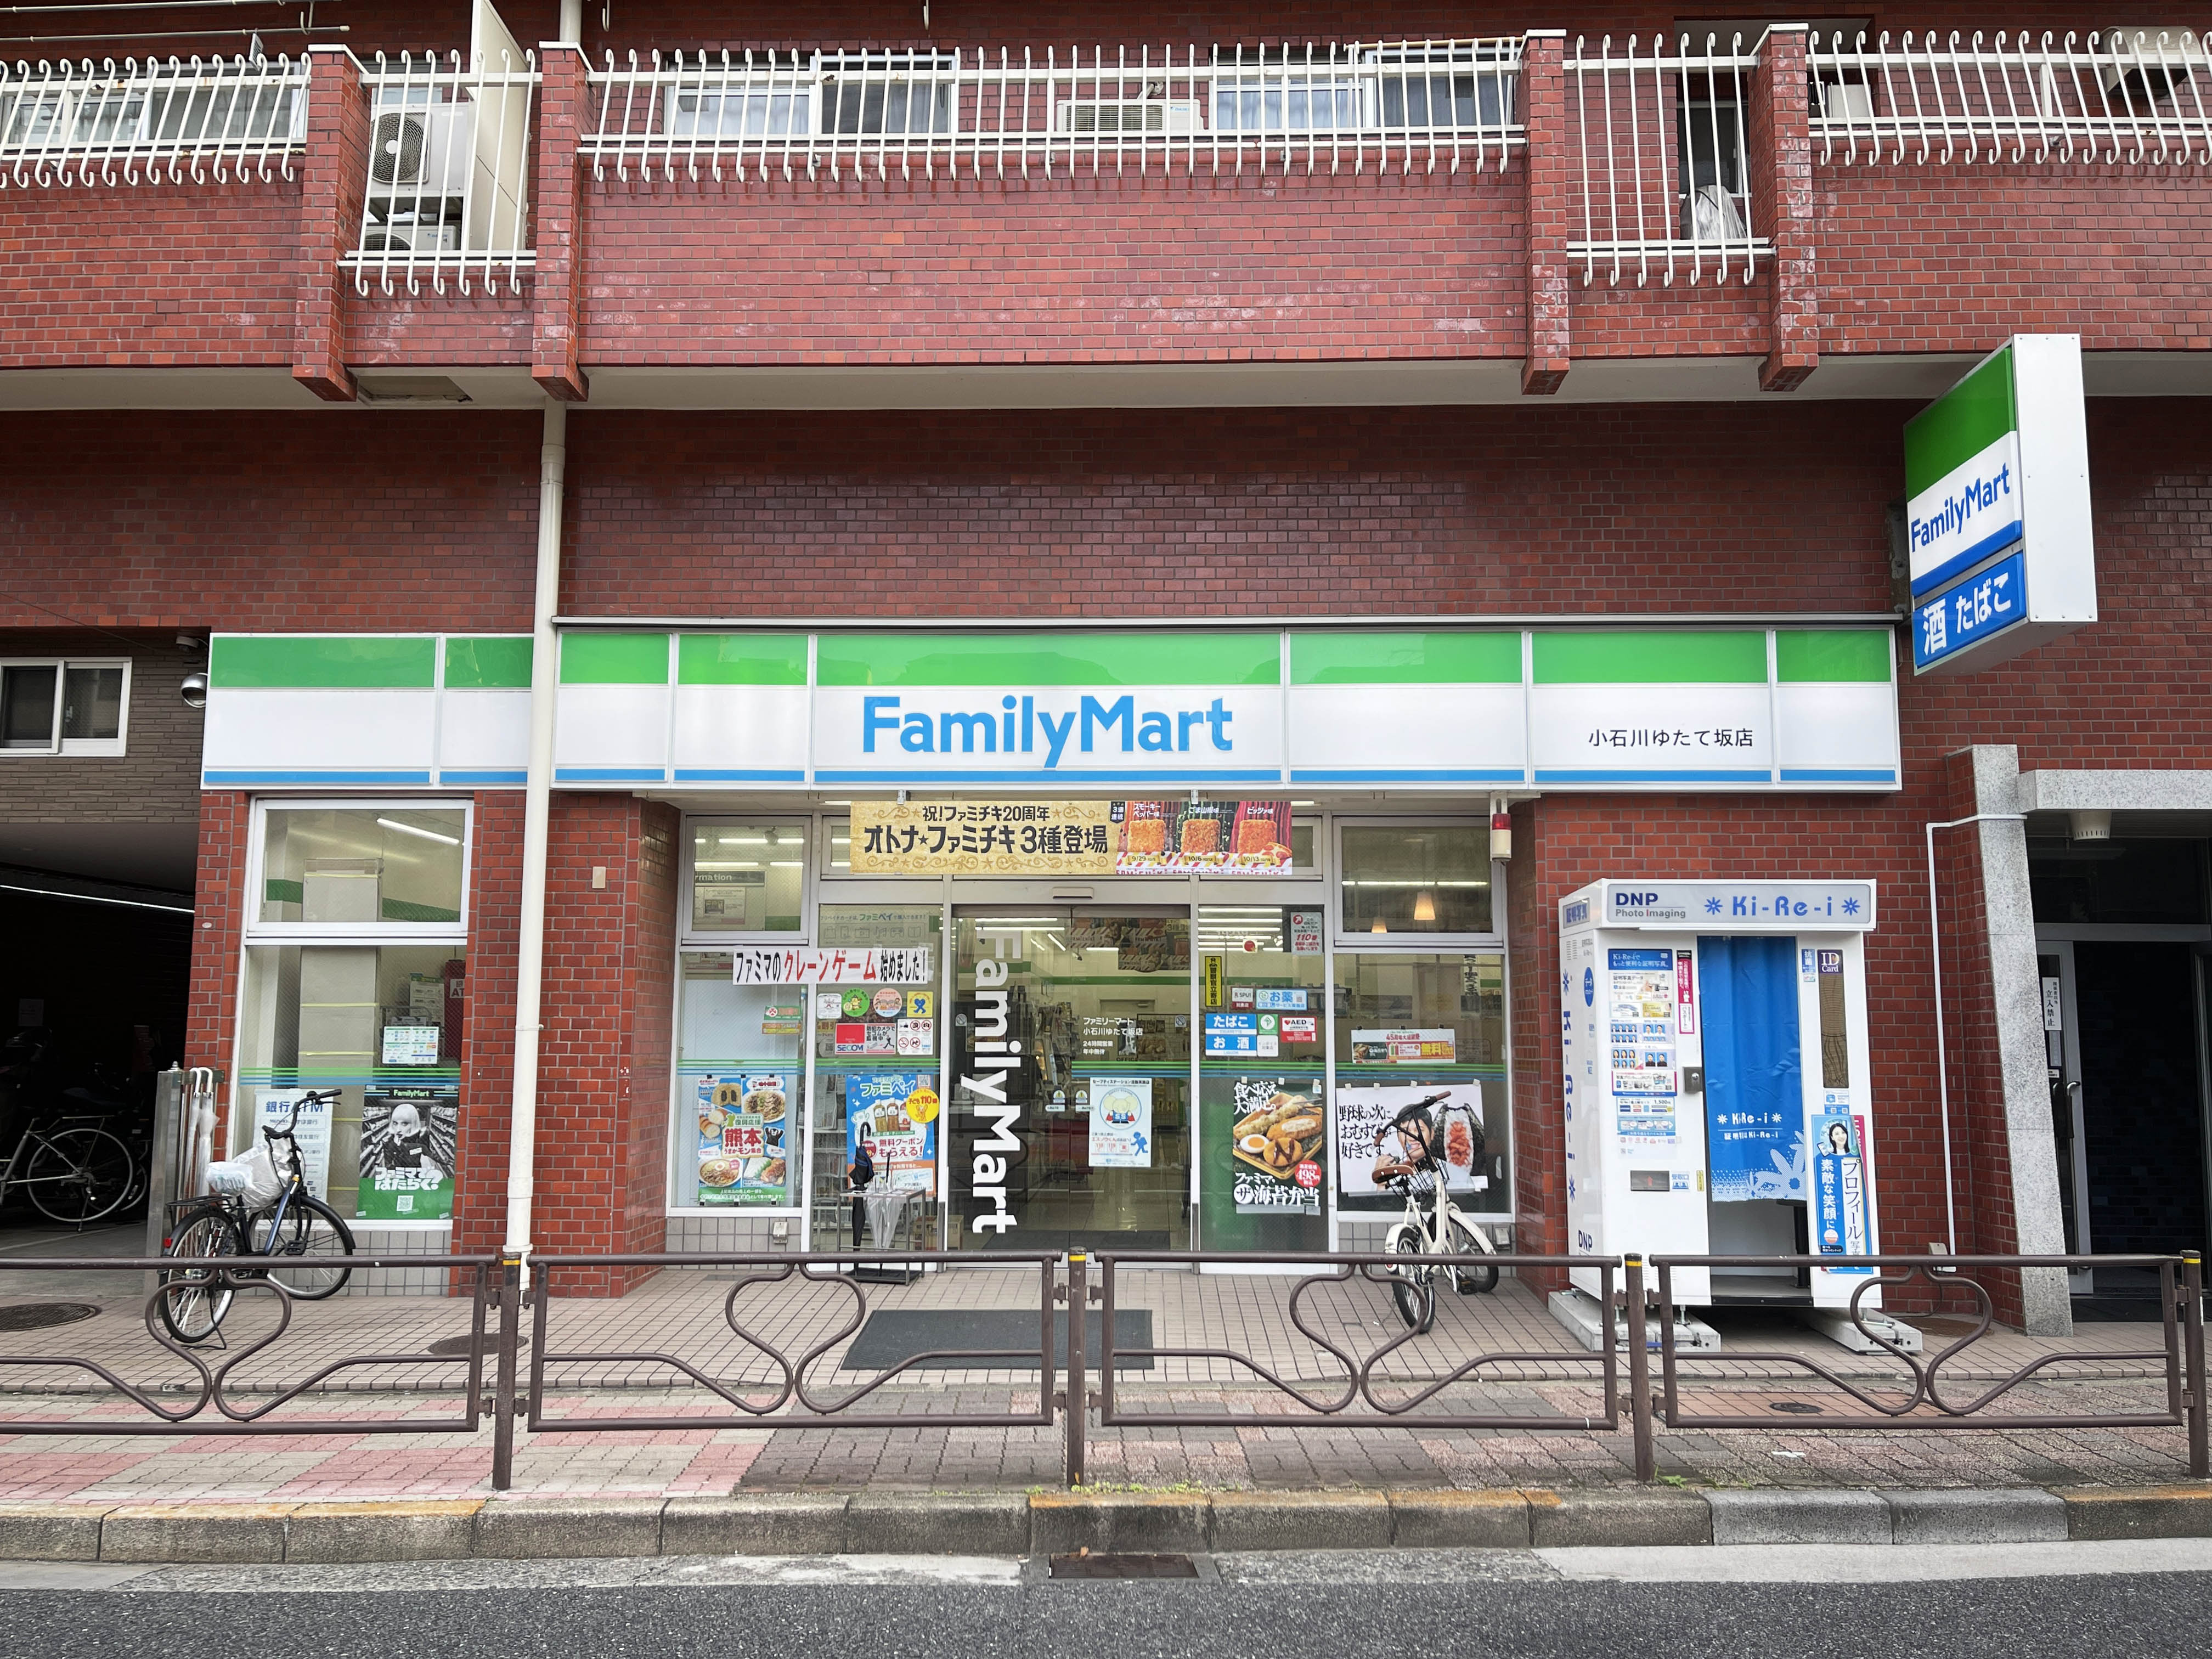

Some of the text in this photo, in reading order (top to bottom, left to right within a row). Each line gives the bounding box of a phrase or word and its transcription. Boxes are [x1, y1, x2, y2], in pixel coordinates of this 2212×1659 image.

[1911, 462, 2010, 552] FamilyMart
[1922, 572, 2011, 656] 酒 たばこ
[864, 695, 1233, 768] FamilyMart
[1589, 728, 1753, 747] 小石川ゆたて坂店
[1615, 893, 1658, 906] DNP
[1615, 909, 1686, 919] Photo Imaging
[1821, 952, 1839, 966] ID
[1270, 991, 1293, 1002] お薬
[2046, 990, 2055, 1026] 立入禁止
[1083, 1017, 1133, 1025] ファミリーマート
[1214, 1015, 1249, 1028] たばこ
[1083, 1028, 1143, 1036] 小石川ゆたて坂店
[860, 1080, 916, 1097] ファミペイ
[961, 932, 1022, 1234] FamilyMart
[1234, 1081, 1279, 1098] 食べ応え
[1233, 1096, 1277, 1115] 大満足。
[725, 1128, 761, 1147] 熊本
[879, 1137, 923, 1147] 無料クーポン
[879, 1146, 923, 1158] もらえる!
[1821, 1159, 1837, 1228] 素敵な笑顔に
[1578, 1230, 1593, 1252] DNP
